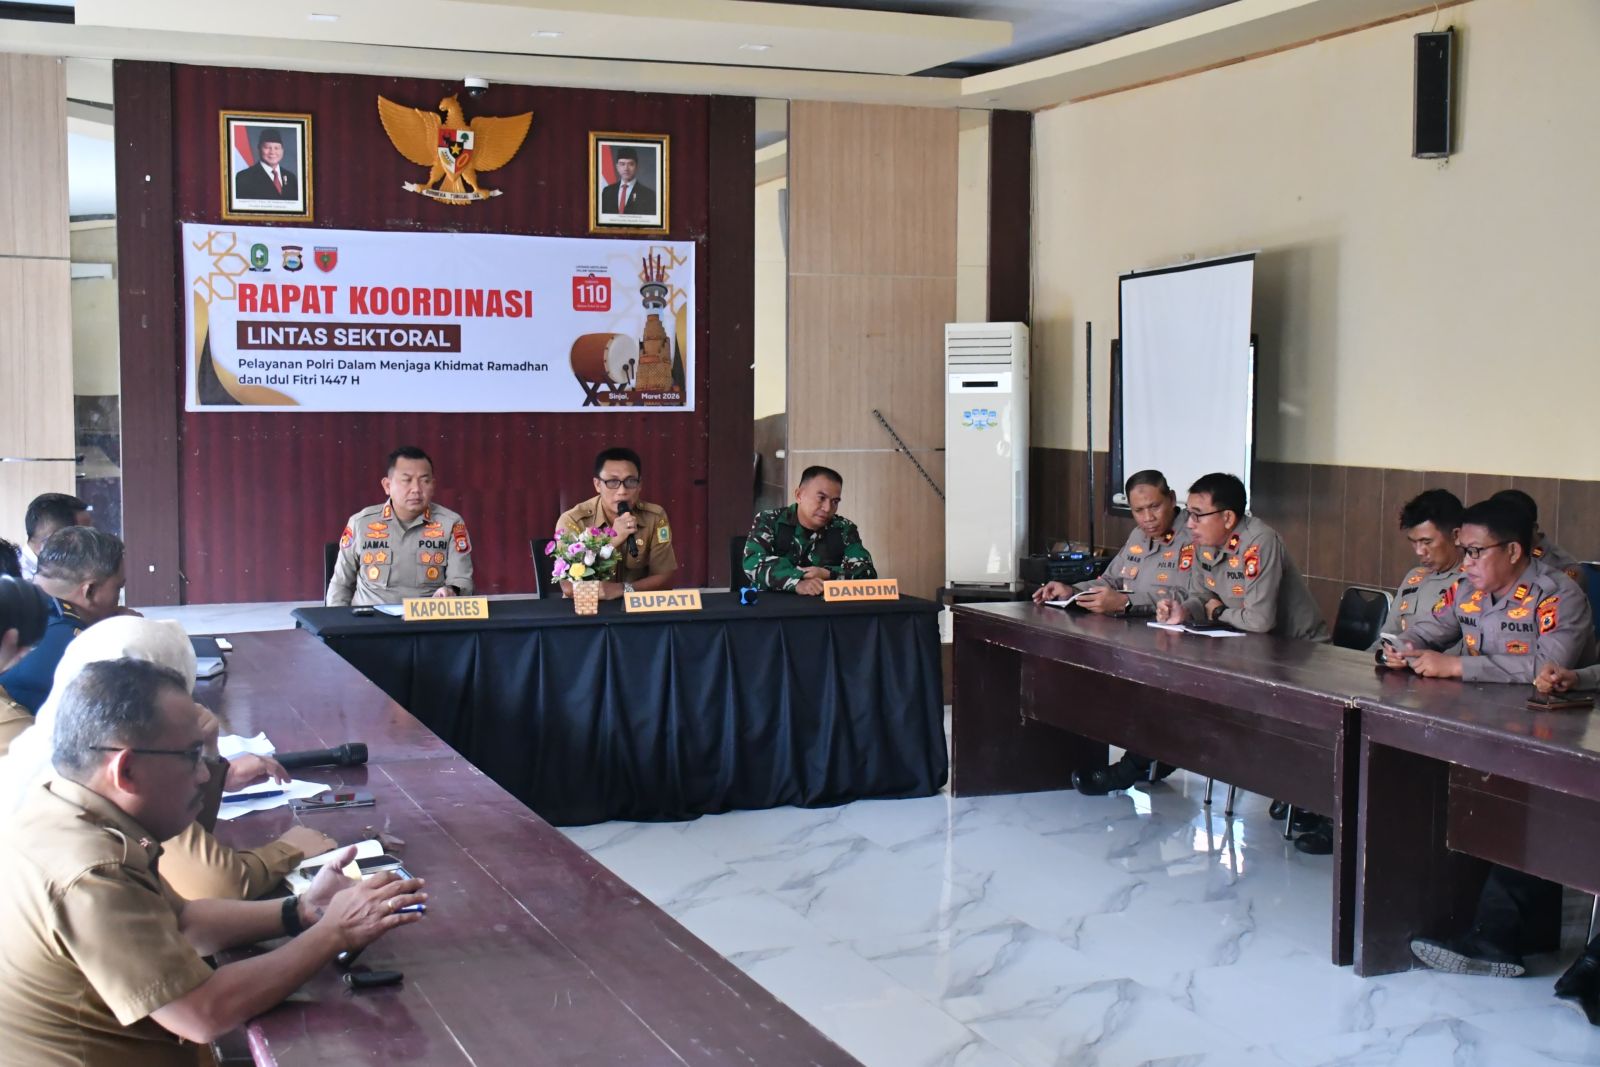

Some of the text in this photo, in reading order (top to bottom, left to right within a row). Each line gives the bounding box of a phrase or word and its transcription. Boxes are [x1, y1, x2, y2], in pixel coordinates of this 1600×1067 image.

[238, 283, 533, 318] RAPAT KOORDINASI
[576, 284, 607, 303] 110
[247, 326, 451, 347] LINTAS SEKTORAL
[238, 358, 548, 372] Pelayanan Polri Dalam Menjaga Khidmat Ramadhan
[238, 374, 360, 385] dan Idul Fitri 1447 H
[362, 541, 389, 549] JAMAL
[419, 540, 447, 550] POLRI
[1227, 571, 1245, 579] POLRI
[829, 584, 897, 598] DANDIM
[630, 593, 695, 608] BUPATI
[410, 599, 480, 617] KAPOLRES
[1501, 621, 1533, 632] POLRI
